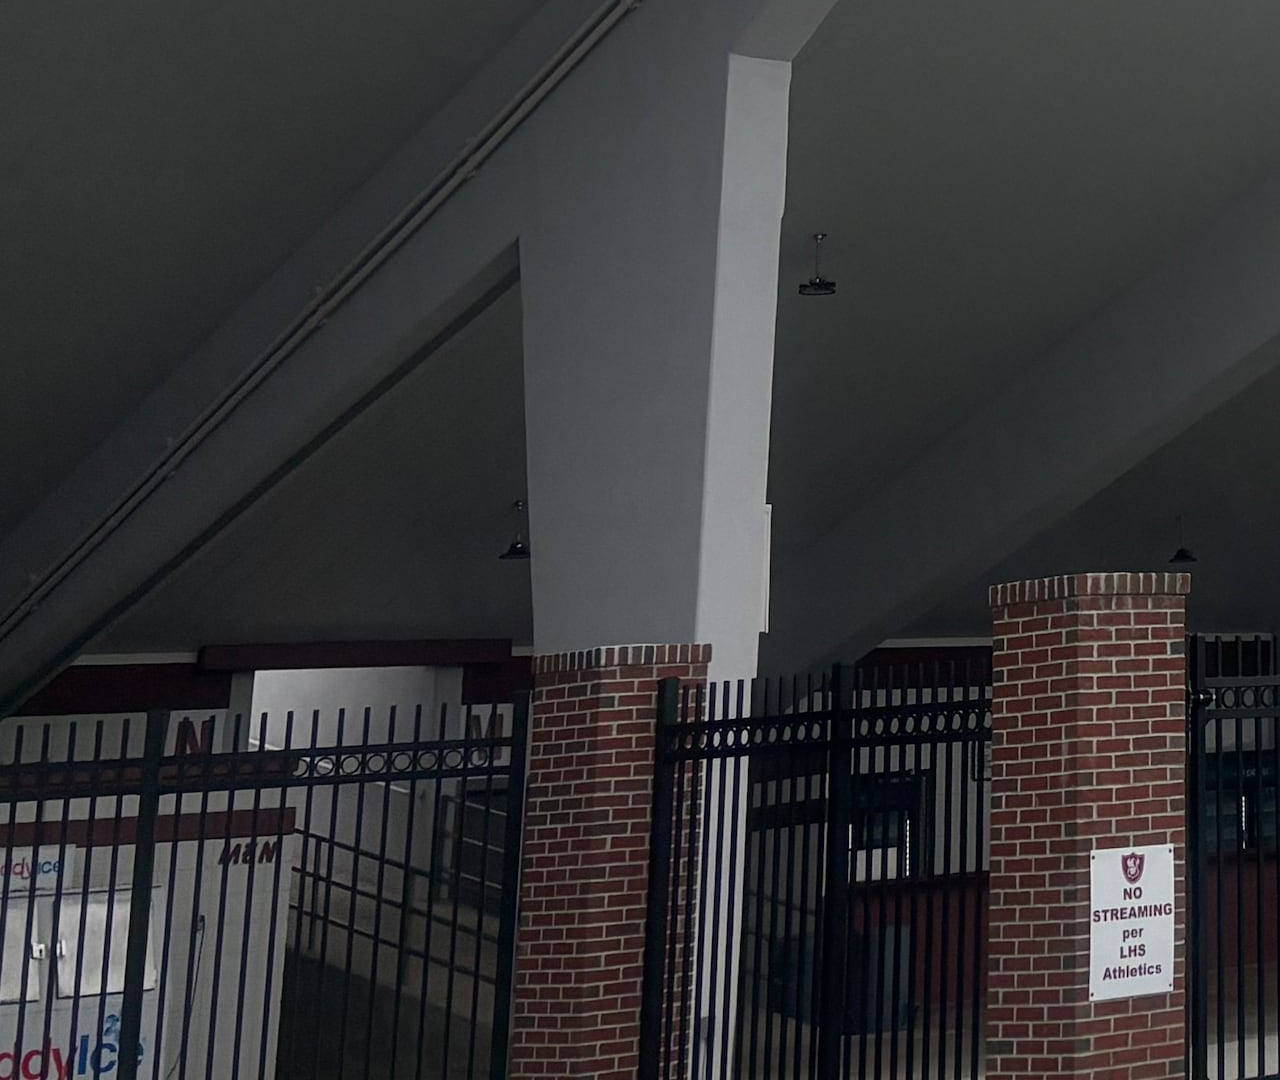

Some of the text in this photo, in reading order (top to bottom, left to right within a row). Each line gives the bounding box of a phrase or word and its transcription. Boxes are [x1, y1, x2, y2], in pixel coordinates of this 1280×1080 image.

[1123, 887, 1143, 901] NO
[1092, 903, 1173, 923] STREAMING
[1122, 927, 1144, 942] per
[1119, 944, 1146, 959] LHS
[1102, 963, 1162, 981] Athletics
